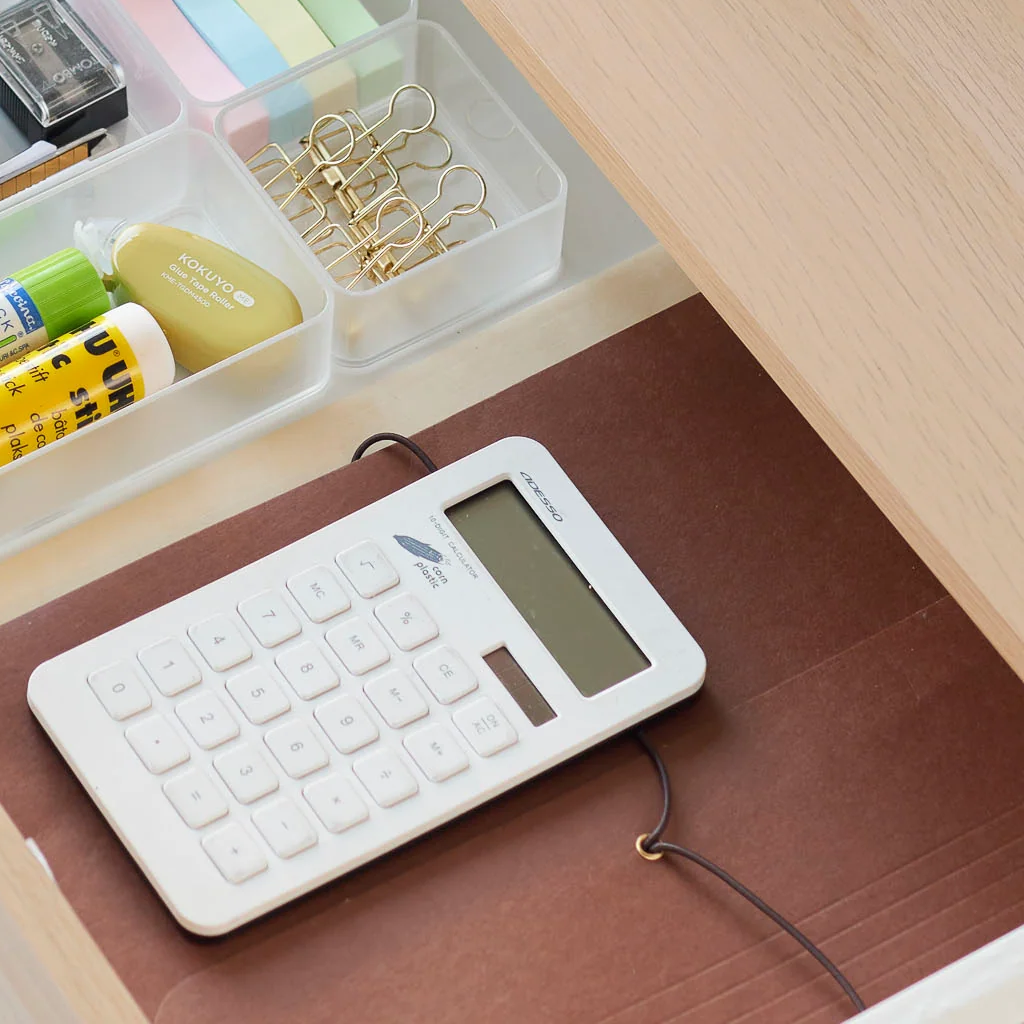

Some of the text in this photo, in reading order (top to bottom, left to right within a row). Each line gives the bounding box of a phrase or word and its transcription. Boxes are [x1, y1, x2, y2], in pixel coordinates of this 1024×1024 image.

[177, 252, 234, 293] KOKUYO
[169, 263, 236, 311] Glue Tape Roller
[29, 412, 50, 432] de
[447, 541, 479, 580] CALCULATOR
[413, 561, 440, 589] plastic
[432, 565, 448, 585] corn
[309, 582, 326, 600] MC
[261, 609, 277, 619] 7
[213, 636, 226, 645] 4
[348, 634, 365, 652] MR
[162, 660, 175, 670] 1
[300, 663, 314, 674] 8
[439, 663, 455, 679] CE
[112, 682, 126, 694] 0
[250, 687, 265, 698] 5
[200, 712, 214, 724] 2
[340, 715, 354, 726] 9
[290, 741, 304, 752] 6
[239, 765, 253, 776] 3
